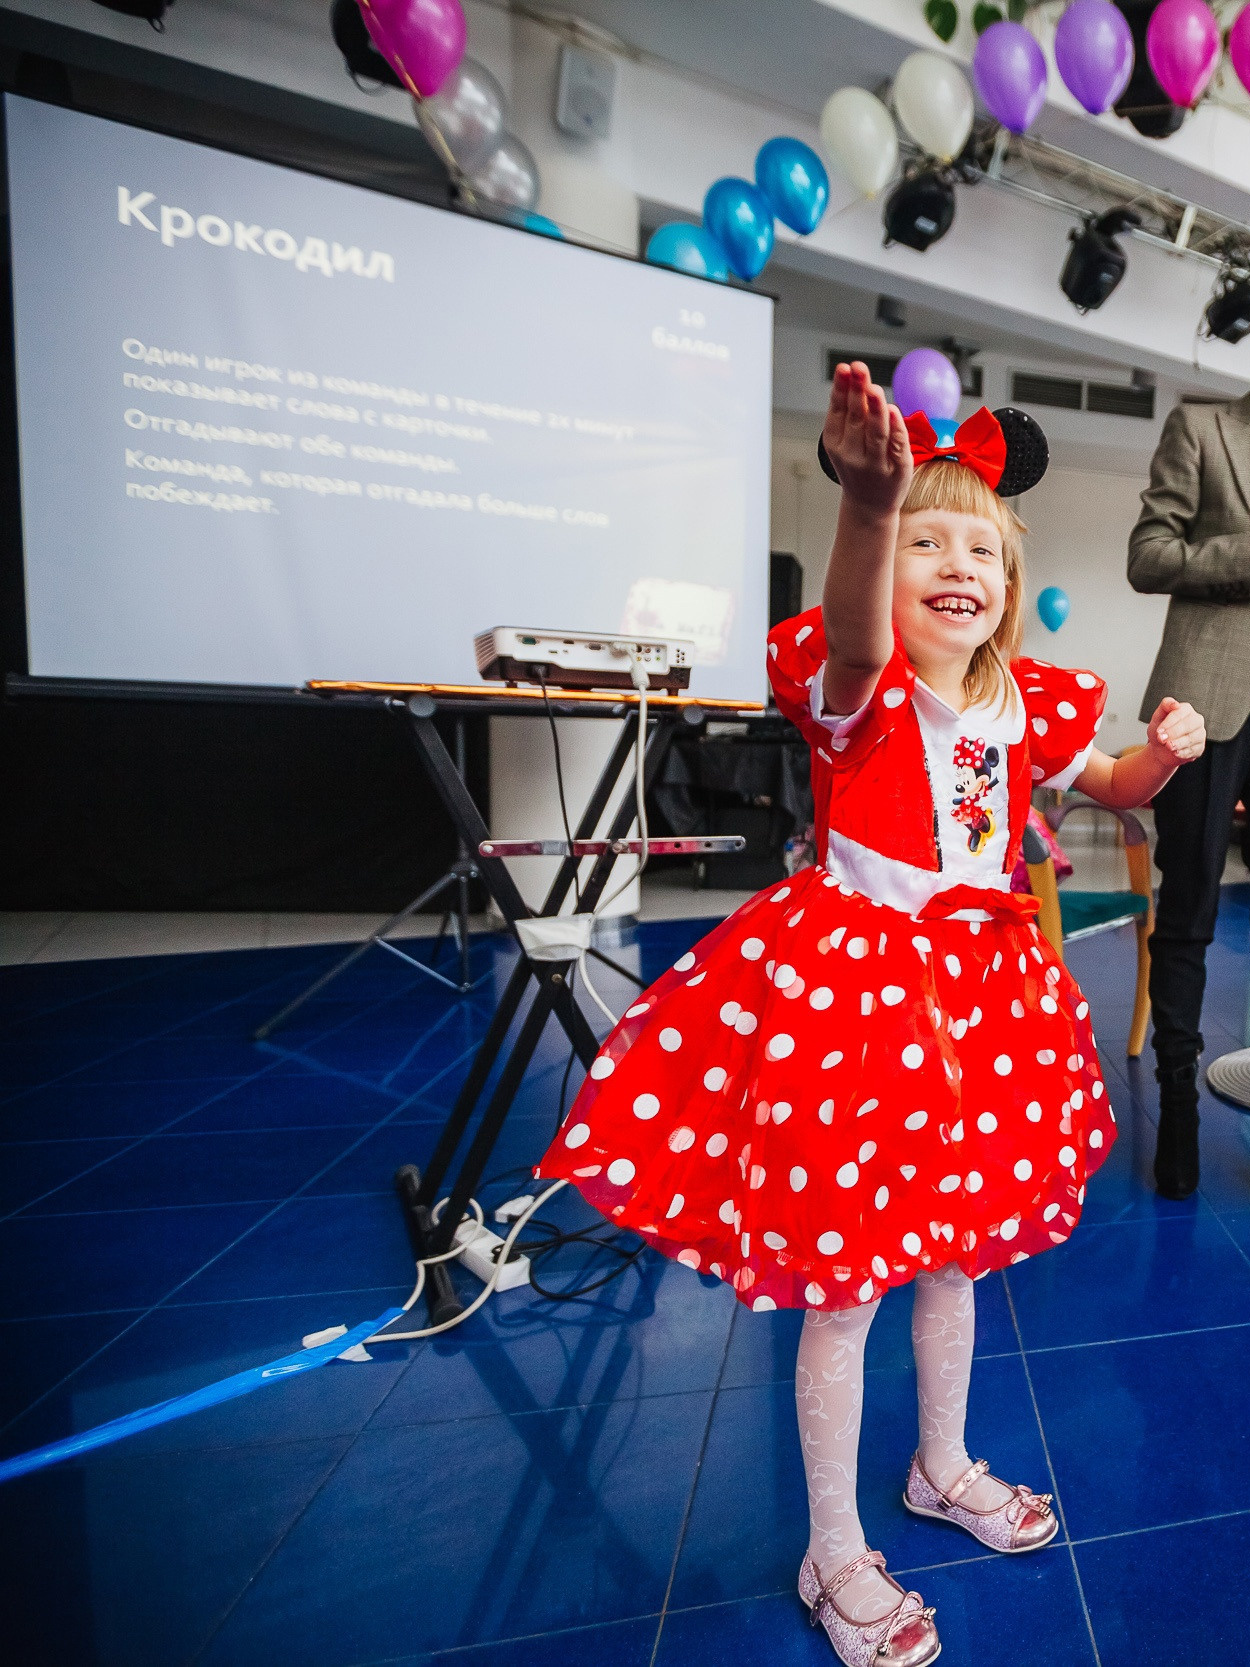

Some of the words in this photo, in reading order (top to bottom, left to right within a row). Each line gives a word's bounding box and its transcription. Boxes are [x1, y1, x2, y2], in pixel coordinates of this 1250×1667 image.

[117, 185, 395, 284] Крокодил
[651, 326, 731, 362] баллов
[679, 308, 706, 330] 10
[122, 338, 199, 369] Один
[205, 355, 283, 383] игрок
[287, 368, 319, 389] из
[322, 375, 430, 408] команды
[434, 393, 450, 411] в
[453, 396, 542, 427] течение
[574, 416, 635, 443] минут
[123, 372, 282, 411] показывает
[286, 397, 360, 423] слова
[363, 409, 378, 427] с
[123, 408, 295, 450] Отгадывают
[300, 434, 346, 458] обе
[125, 448, 253, 488] Команда,
[260, 469, 362, 497] которая
[366, 482, 473, 510] отгадала
[477, 492, 558, 523] больше
[561, 507, 610, 529] слов
[126, 481, 280, 515] побеждает.
